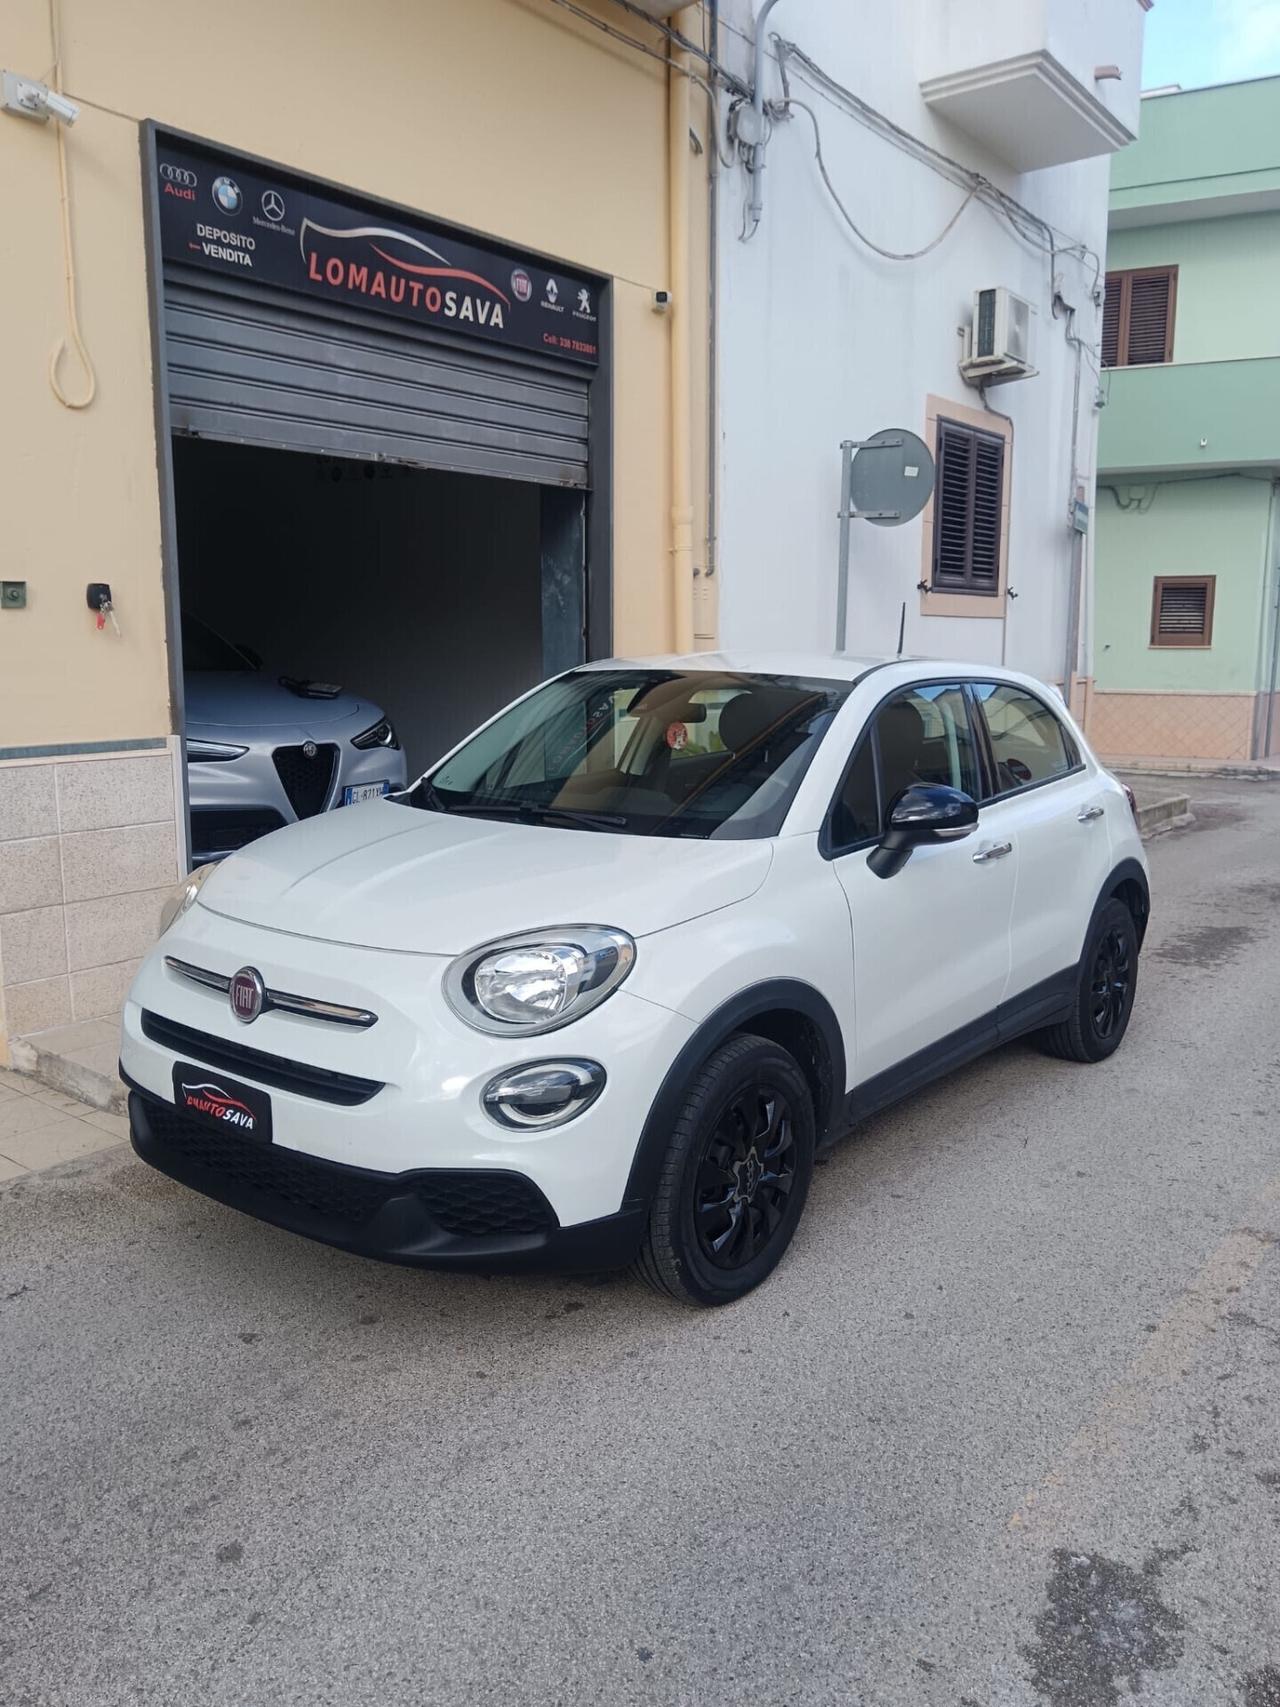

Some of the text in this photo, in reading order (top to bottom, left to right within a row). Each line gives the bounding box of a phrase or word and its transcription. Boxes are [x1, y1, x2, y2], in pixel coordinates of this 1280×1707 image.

[163, 182, 196, 201] Audi
[197, 223, 256, 251] DEPOSITO
[202, 242, 253, 267] VENDITA
[309, 252, 504, 329] LOMAUTOSAVA
[235, 984, 254, 1009] FIAT
